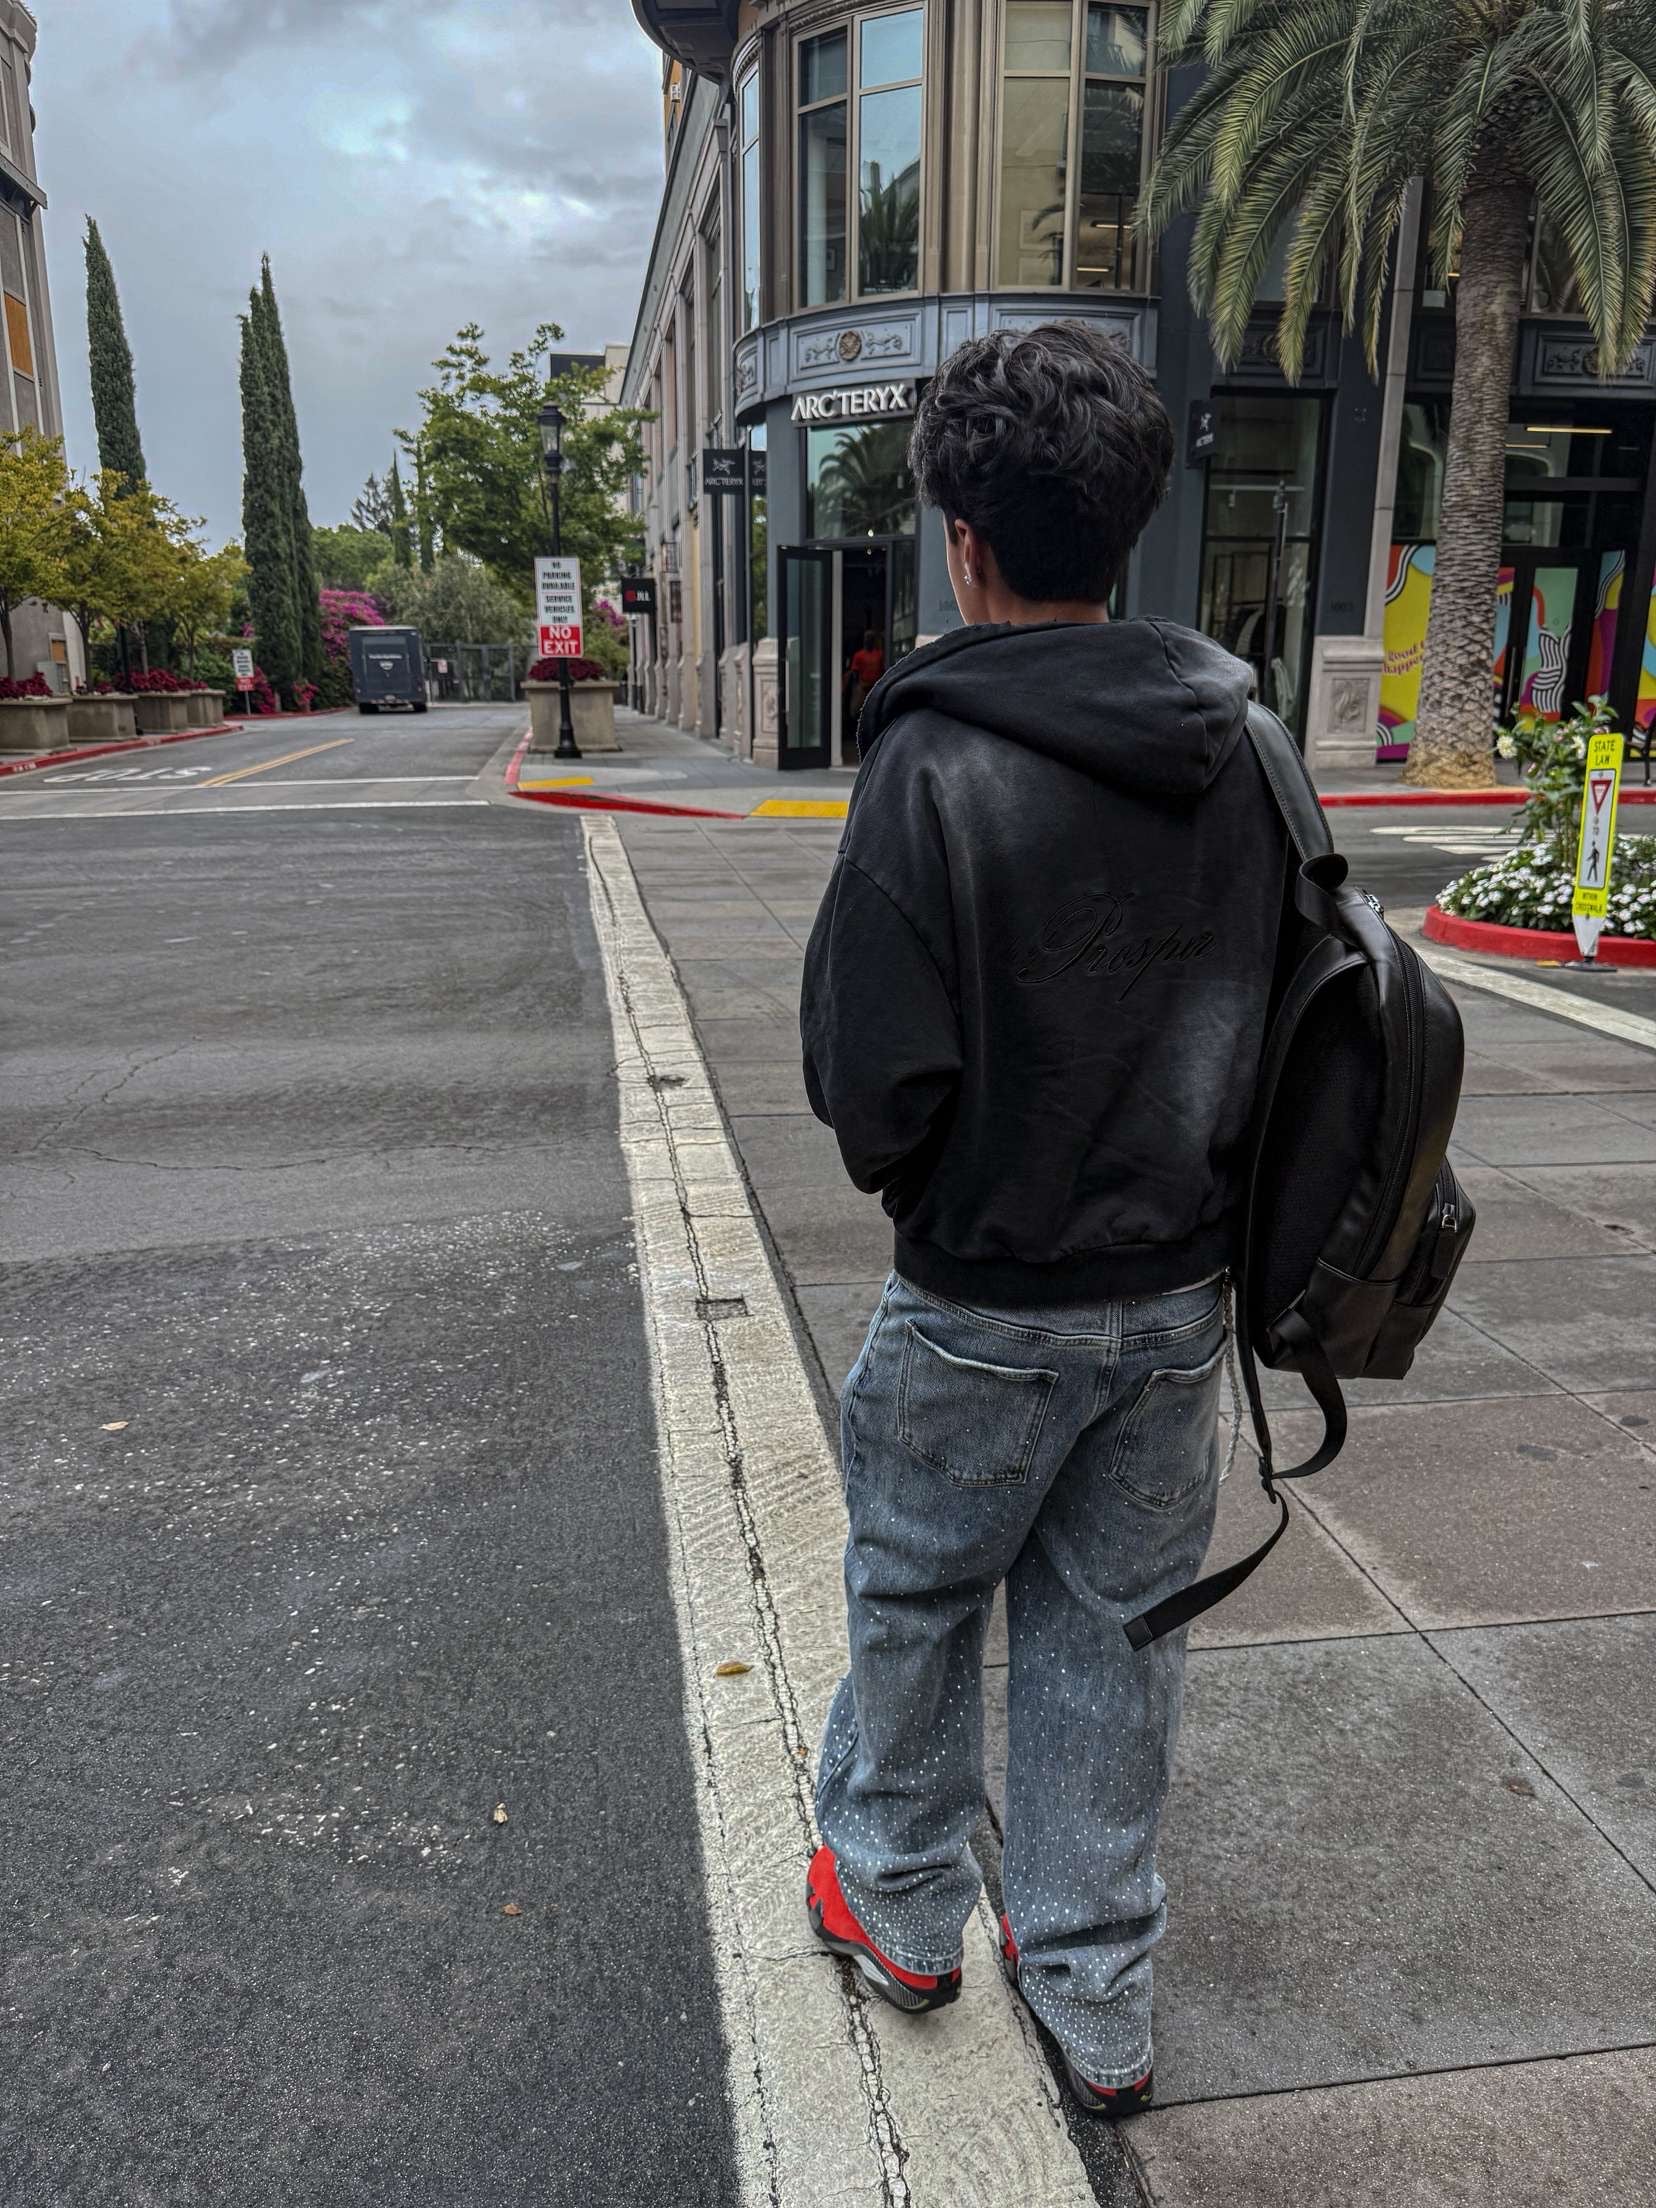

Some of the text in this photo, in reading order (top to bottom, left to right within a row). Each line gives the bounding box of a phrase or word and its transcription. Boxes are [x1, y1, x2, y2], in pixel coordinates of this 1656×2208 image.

[546, 595, 572, 603] SERVICE
[544, 605, 575, 613] VEHICLES
[549, 625, 571, 639] NO
[543, 640, 578, 654] EXIT
[1594, 740, 1615, 752] STATE
[1595, 755, 1610, 766] LAW
